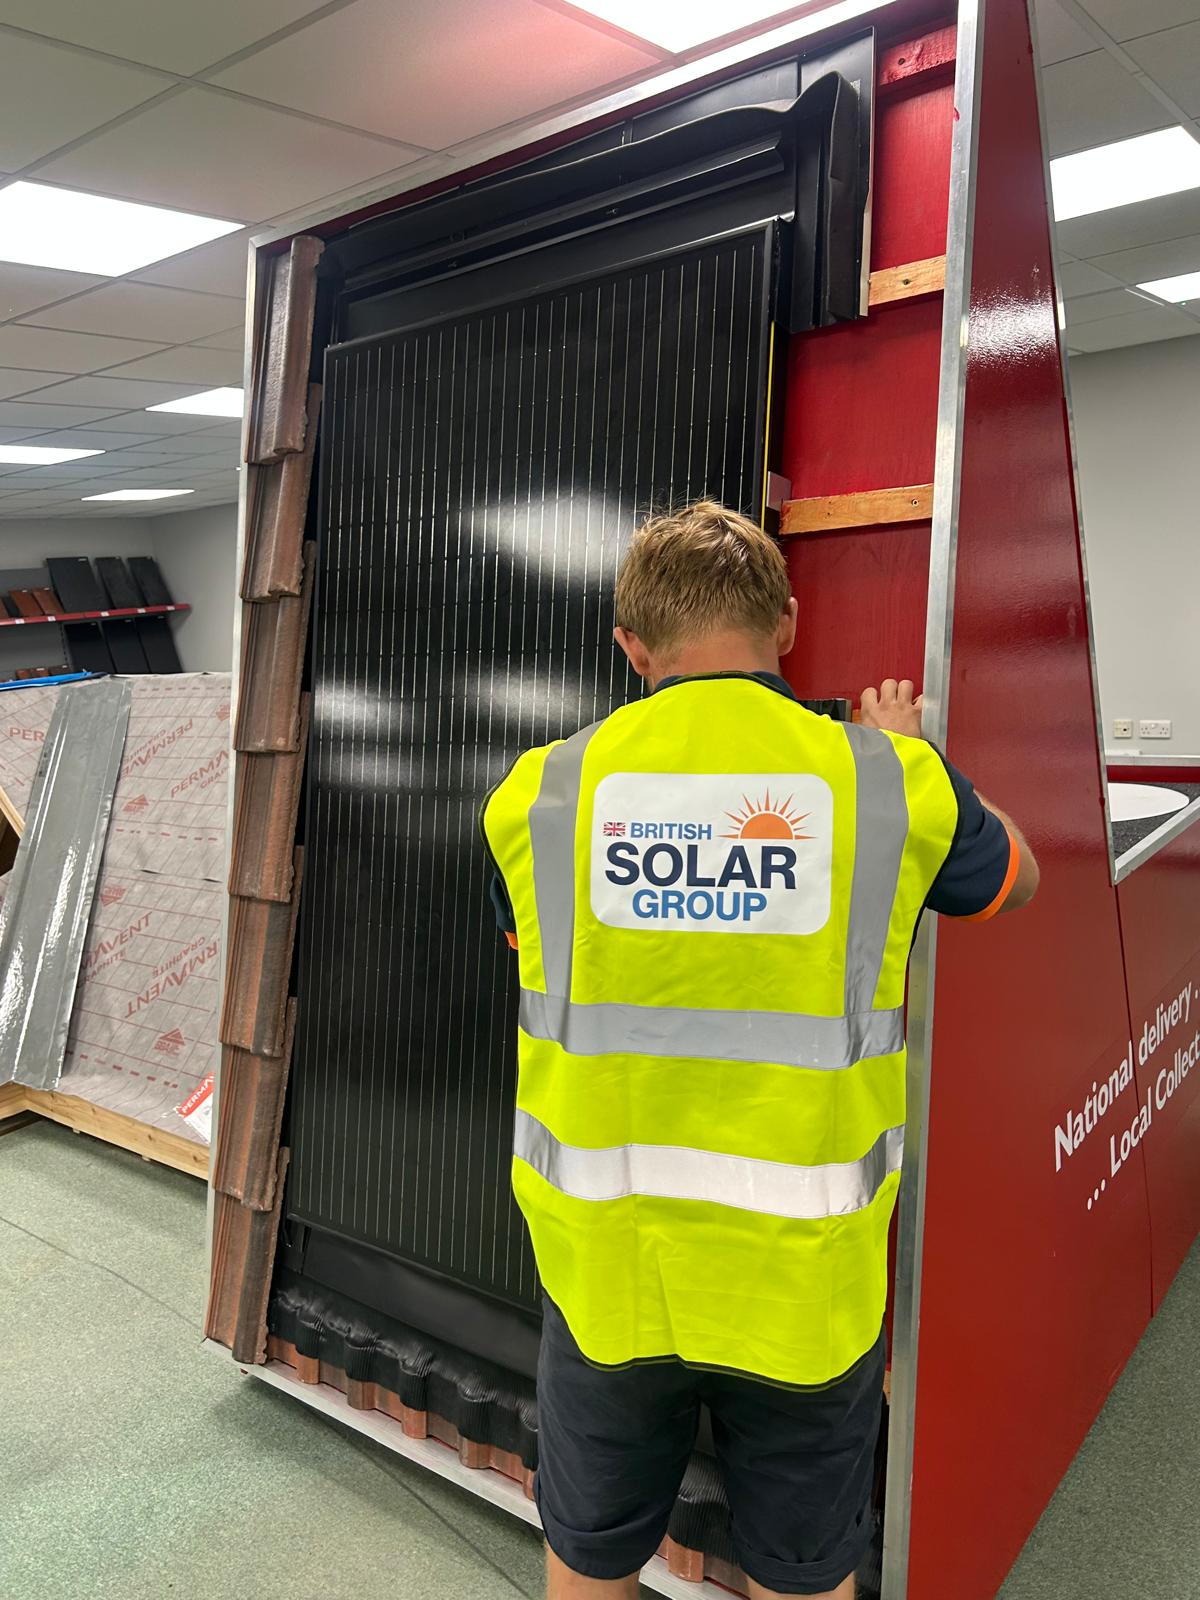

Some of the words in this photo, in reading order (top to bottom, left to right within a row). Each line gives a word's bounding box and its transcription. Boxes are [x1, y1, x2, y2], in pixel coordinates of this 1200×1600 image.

[630, 822, 712, 840] BRITISH
[605, 841, 797, 889] SOLAR
[632, 889, 767, 921] GROUP
[125, 938, 220, 1018] RMAVENT
[1054, 1039, 1134, 1173] National
[1110, 1086, 1152, 1178] Local
[1155, 1029, 1200, 1111] Collect
